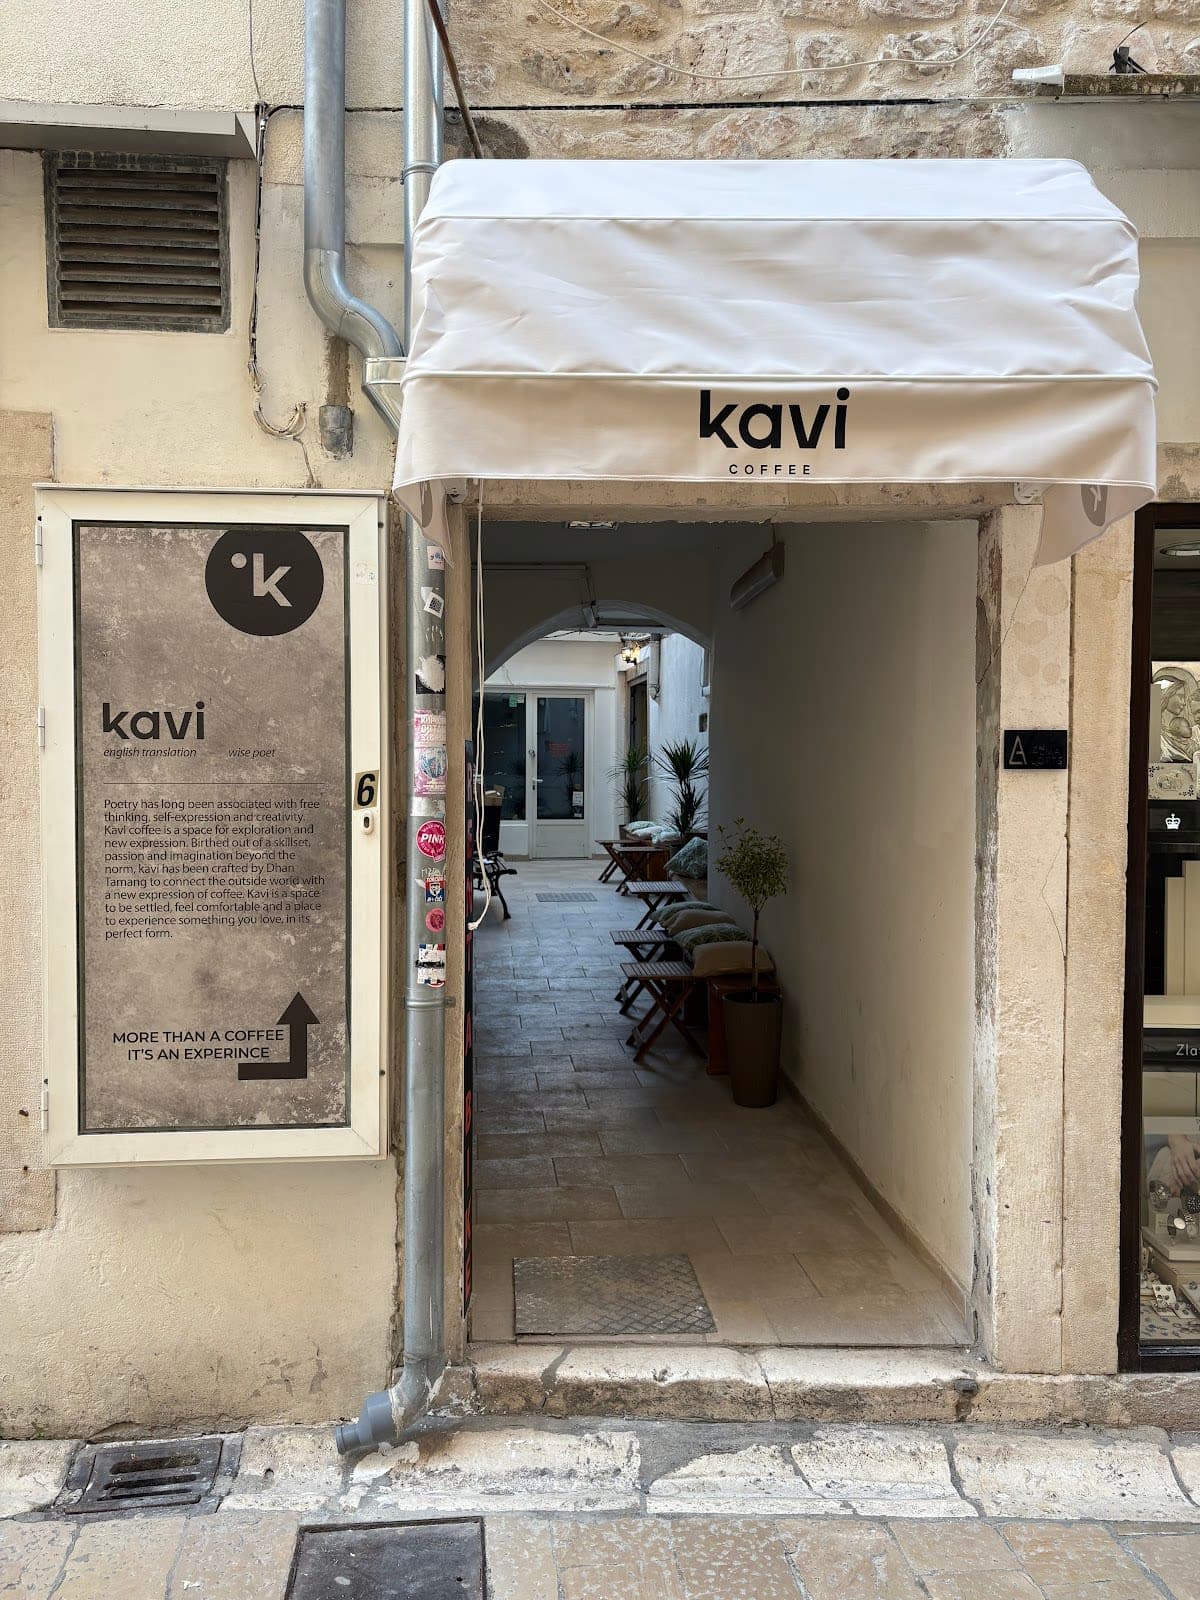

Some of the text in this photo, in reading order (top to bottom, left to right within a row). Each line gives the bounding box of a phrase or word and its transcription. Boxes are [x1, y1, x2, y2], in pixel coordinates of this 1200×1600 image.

[700, 387, 850, 449] kavi
[729, 464, 811, 475] COFFEE
[102, 701, 205, 740] kavi
[103, 747, 197, 759] english translation
[228, 747, 275, 760] wise poet
[357, 774, 375, 806] 6
[104, 799, 320, 811] Poetry has long been associated with free
[153, 812, 230, 824] self-expression
[233, 812, 253, 821] and
[104, 825, 126, 835] Kavi
[129, 825, 161, 834] coffee
[164, 825, 171, 834] is
[182, 827, 212, 837] space
[215, 825, 230, 834] for
[232, 825, 291, 836] exploration
[294, 824, 313, 834] and
[130, 838, 187, 850] expression.
[191, 838, 229, 847] Birthed
[231, 838, 250, 847] out
[252, 838, 264, 847] of
[273, 838, 311, 848] skillset,
[421, 833, 446, 844] PINK
[105, 850, 295, 863] passion and imagination beyond the
[105, 863, 295, 875] norm, kavi has been crafted by Dhan
[105, 876, 325, 889] Tamang to connect the outside world with
[139, 889, 195, 901] expression
[197, 889, 209, 898] of
[247, 889, 269, 898] Kavi
[271, 888, 279, 898] is
[282, 890, 288, 898] a
[290, 890, 320, 900] space
[105, 901, 321, 913] to be settled, feel comfortable and a place
[105, 916, 116, 925] to
[119, 916, 176, 927] experience
[178, 915, 235, 927] something
[238, 917, 257, 926] you
[286, 914, 295, 924] in
[298, 914, 310, 924] its
[105, 928, 173, 941] perfect form.
[112, 1029, 284, 1043] MORE THAN A COFFEE
[128, 1047, 270, 1060] IT'S AN EXPERINCE
[1176, 1043, 1200, 1056] Zla
